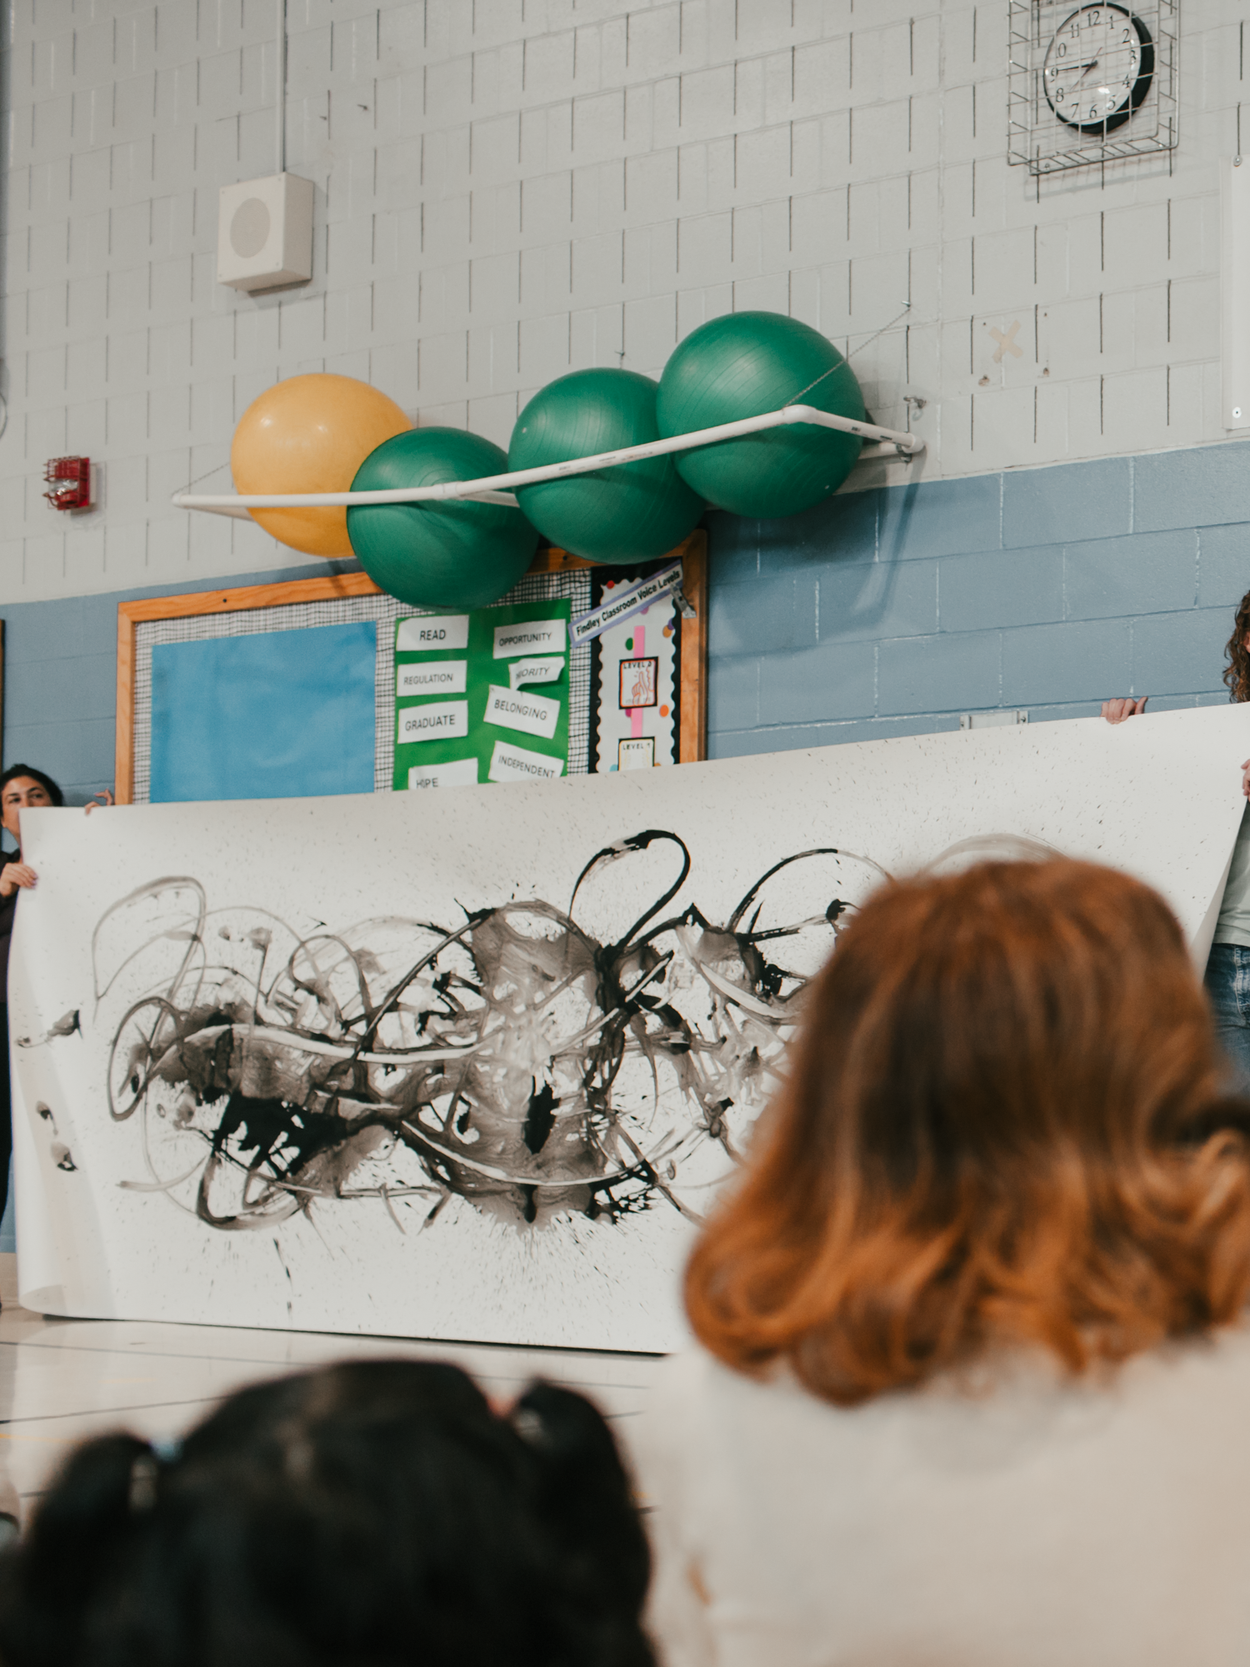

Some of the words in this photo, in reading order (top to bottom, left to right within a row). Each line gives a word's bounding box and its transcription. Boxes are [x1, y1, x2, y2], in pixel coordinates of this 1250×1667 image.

[1087, 10, 1101, 27] 12
[1110, 15, 1115, 30] 1
[1070, 24, 1080, 38] 11
[1122, 28, 1130, 44] 2
[1055, 87, 1064, 103] 8
[1071, 102, 1080, 118] 7
[1089, 104, 1097, 119] 6
[576, 617, 601, 636] Findley
[602, 596, 638, 621] Classroom
[637, 583, 657, 600] Voice
[657, 570, 680, 588] Levels
[420, 629, 446, 641] READ
[499, 632, 552, 646] OPPORTUNITY
[623, 661, 645, 669] LEVEL
[403, 673, 453, 685] REGULATION
[494, 699, 547, 721] BELONGING
[405, 714, 455, 731] GRADUATE
[498, 755, 555, 778] INDEPENDENT
